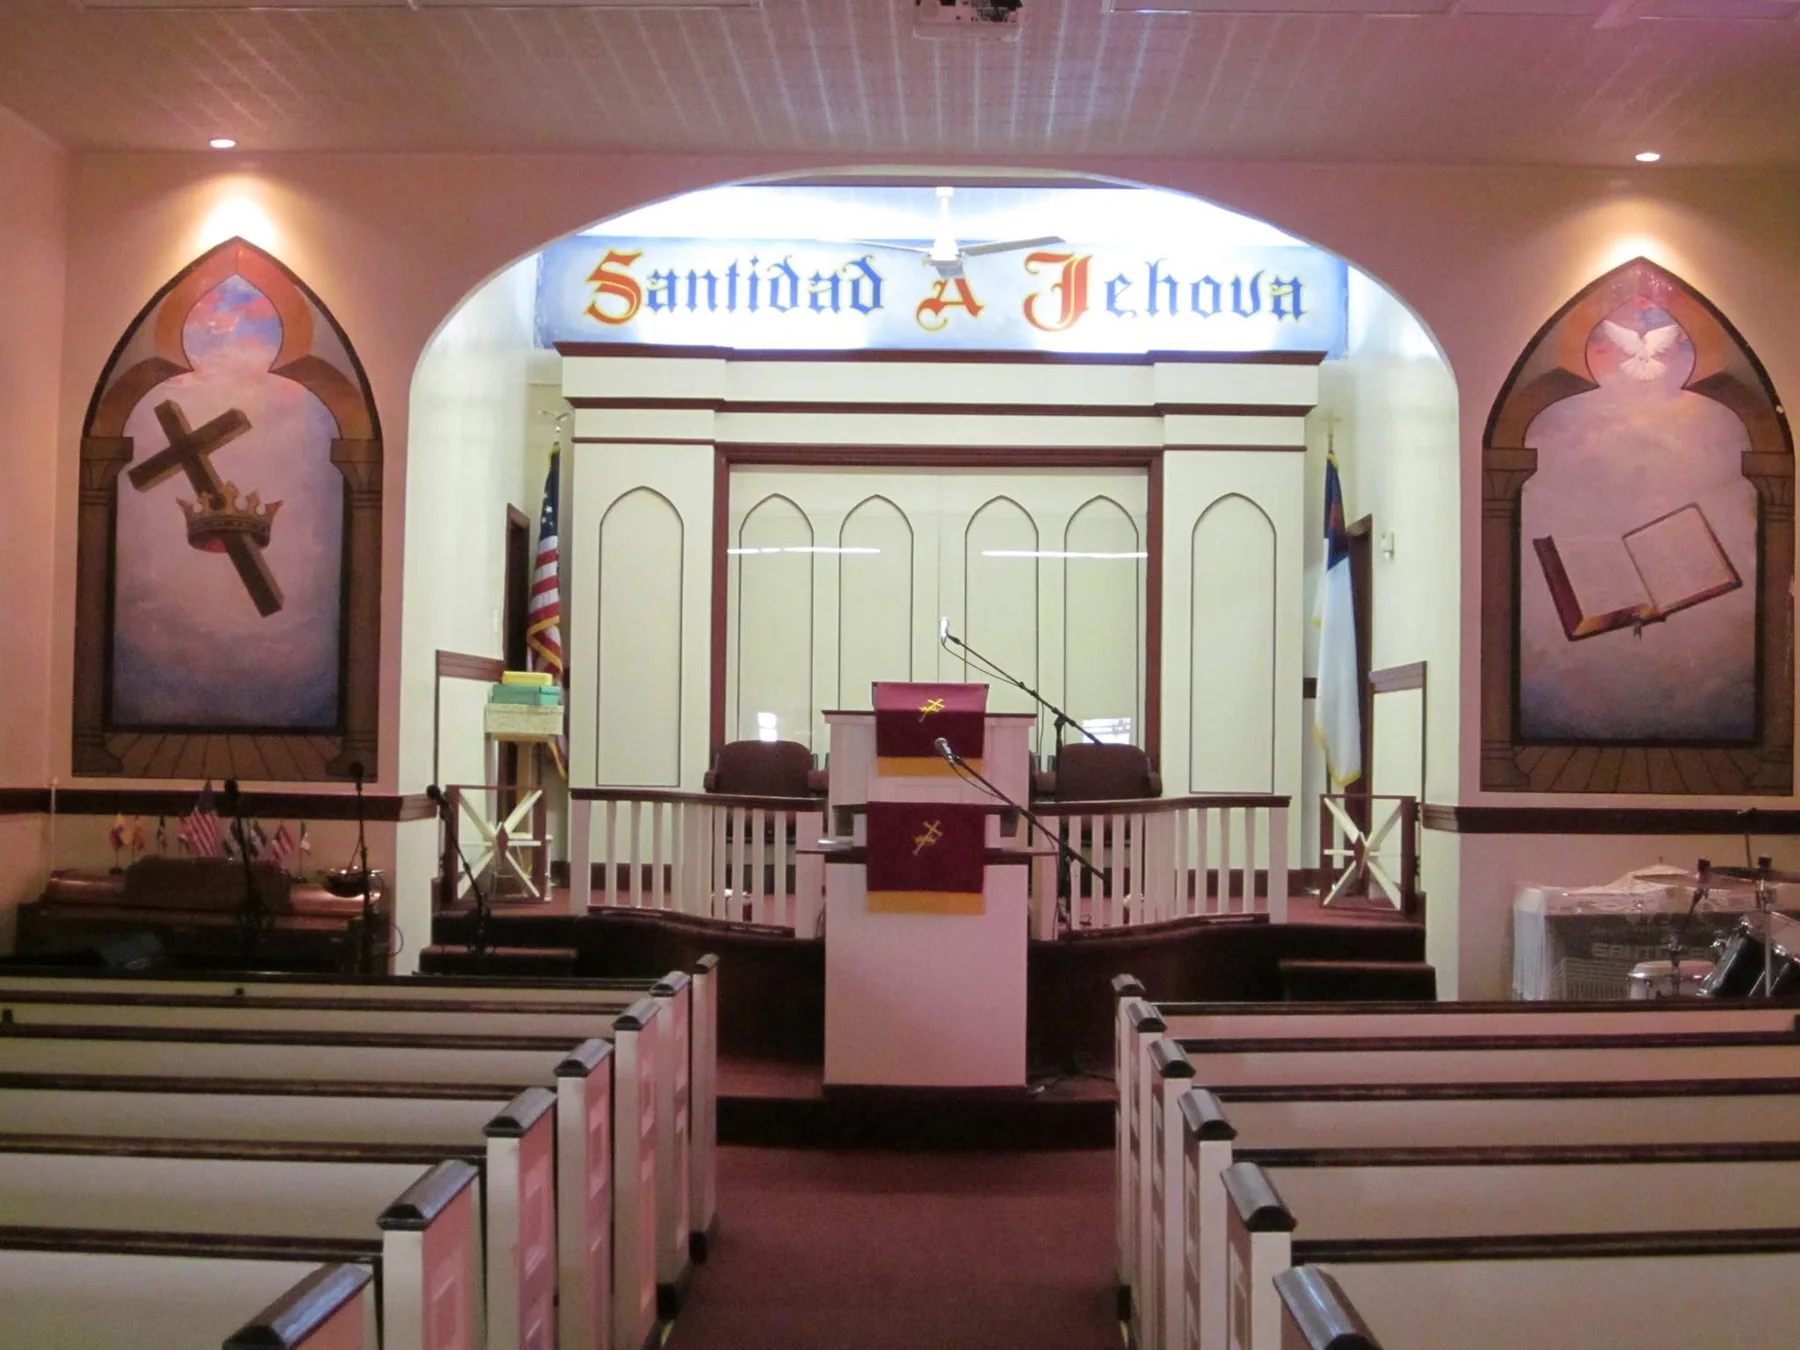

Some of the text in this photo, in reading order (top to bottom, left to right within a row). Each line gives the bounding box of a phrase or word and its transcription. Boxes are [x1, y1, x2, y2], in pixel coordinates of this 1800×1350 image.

[583, 247, 1308, 333] Santidad A Jehova
